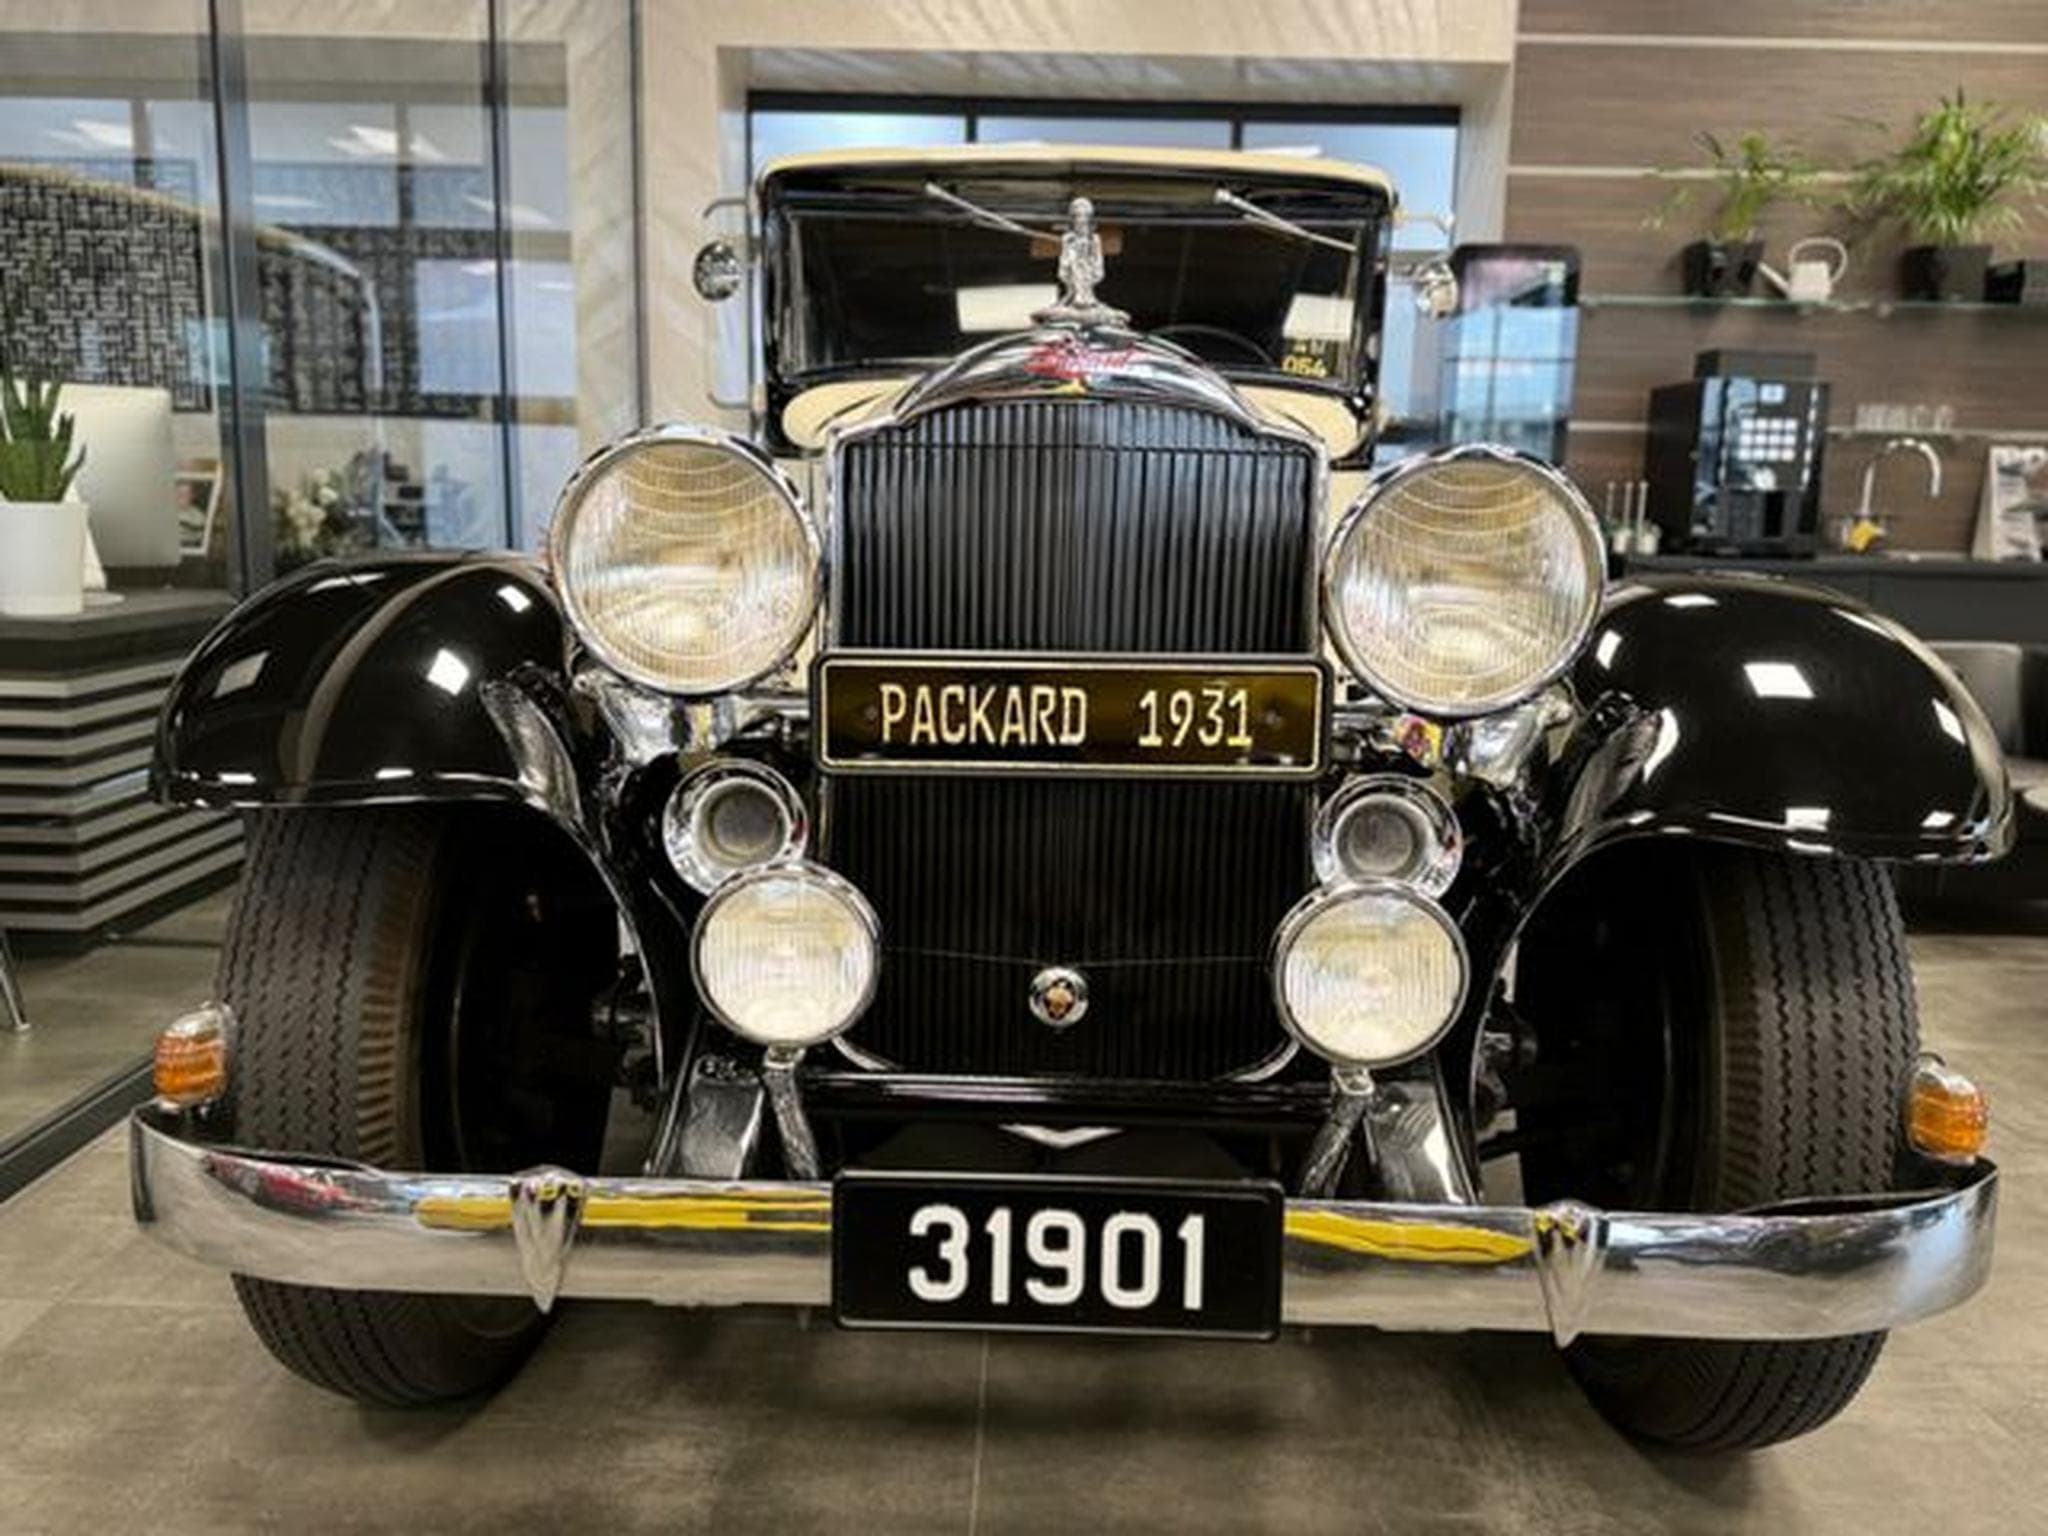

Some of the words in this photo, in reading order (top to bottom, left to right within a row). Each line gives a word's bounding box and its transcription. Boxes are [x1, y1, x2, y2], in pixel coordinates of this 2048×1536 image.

[879, 683, 1088, 746] PACKARD
[1138, 688, 1253, 748] 1931
[908, 1203, 1205, 1310] 31901
